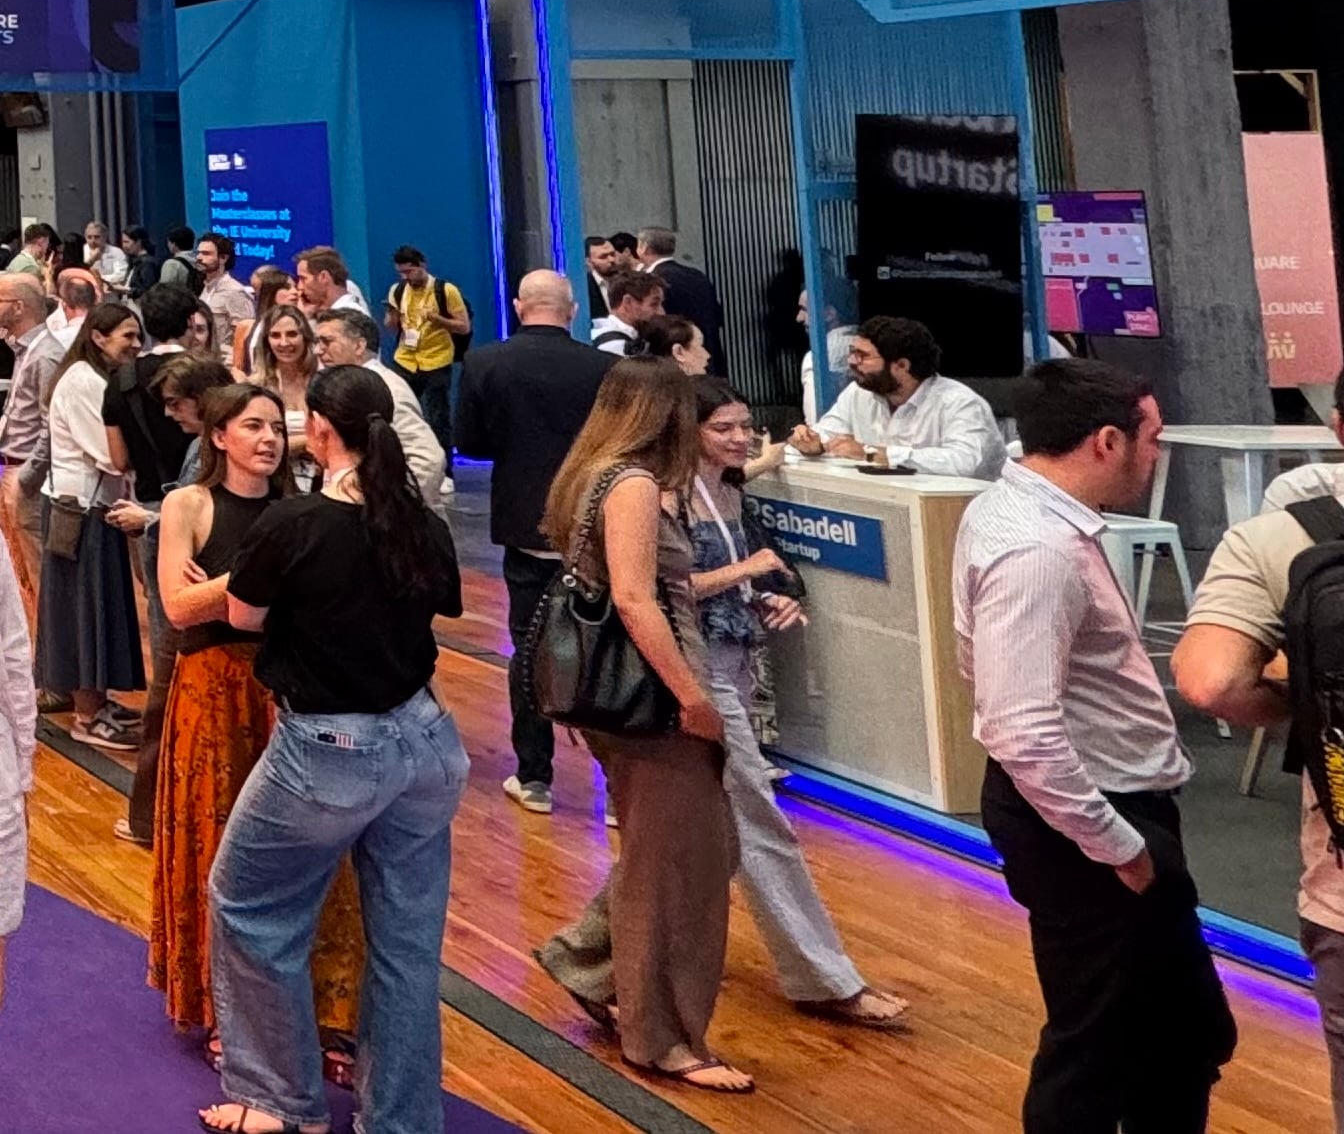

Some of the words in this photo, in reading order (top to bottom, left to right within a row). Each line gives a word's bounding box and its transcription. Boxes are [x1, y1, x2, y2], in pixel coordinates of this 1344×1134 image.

[241, 225, 291, 242] University
[242, 243, 275, 261] Today!
[1254, 256, 1301, 270] UARE
[1261, 301, 1325, 315] LOUNGE
[762, 504, 857, 546] Sabadell
